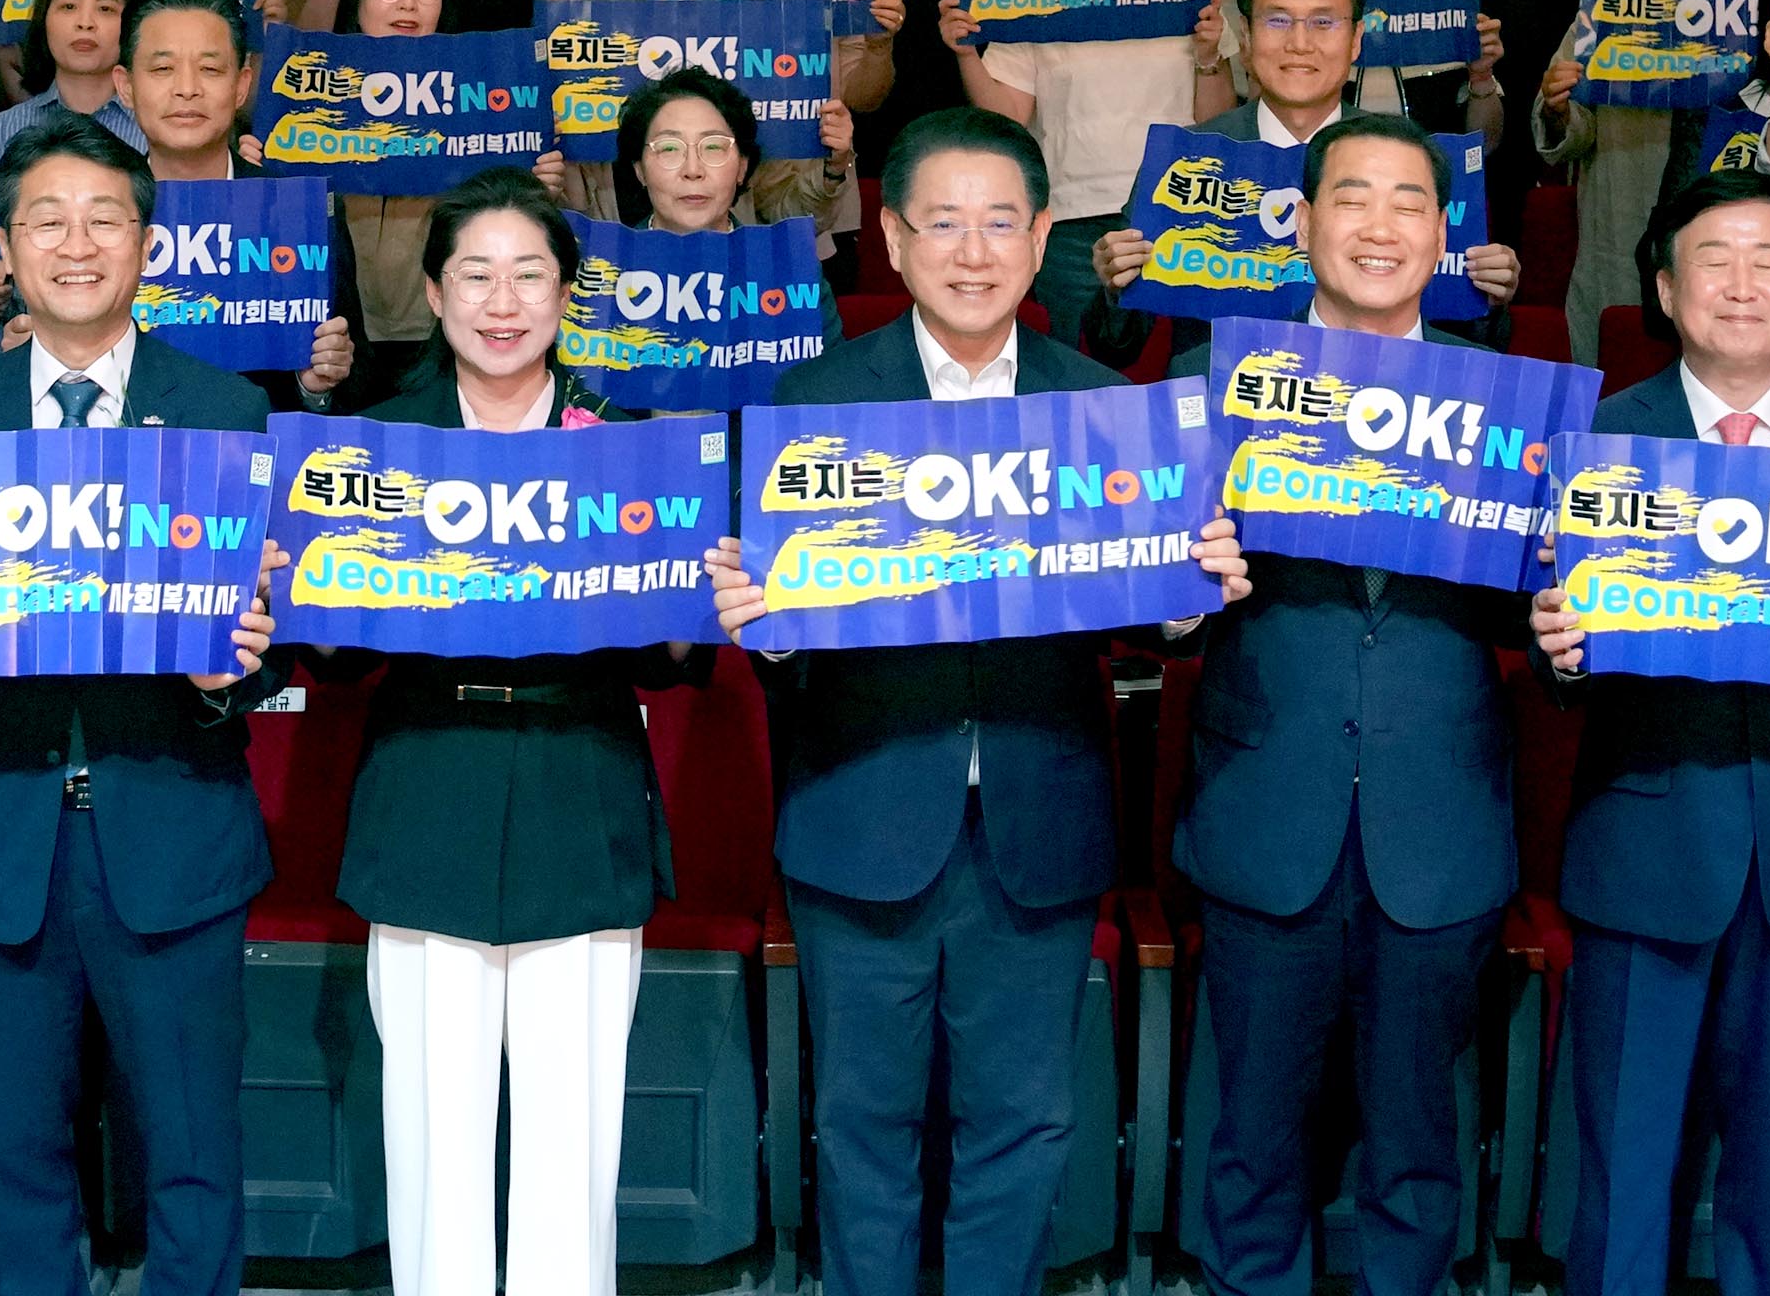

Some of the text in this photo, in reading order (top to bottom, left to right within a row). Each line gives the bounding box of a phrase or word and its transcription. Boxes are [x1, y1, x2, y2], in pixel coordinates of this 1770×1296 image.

[283, 66, 538, 116] 복지는 OK! Now
[277, 128, 542, 157] Jeonnam 사회복지사
[239, 238, 327, 272] Now
[223, 298, 331, 328] 사회복지사
[613, 271, 819, 323] OK! Now
[1236, 371, 1549, 477] 복지는 OK! No
[304, 467, 701, 544] 복지는 OK! Now
[777, 449, 1184, 521] 복지는 OK! Now
[1235, 459, 1441, 520] Jeonnam
[130, 507, 247, 550] Now
[1569, 488, 1678, 533] 복지는
[306, 555, 702, 604] Jeonnam 사회복지사
[780, 531, 1193, 588] Jeonnam 사회복지사
[109, 582, 239, 615] 사회복지사
